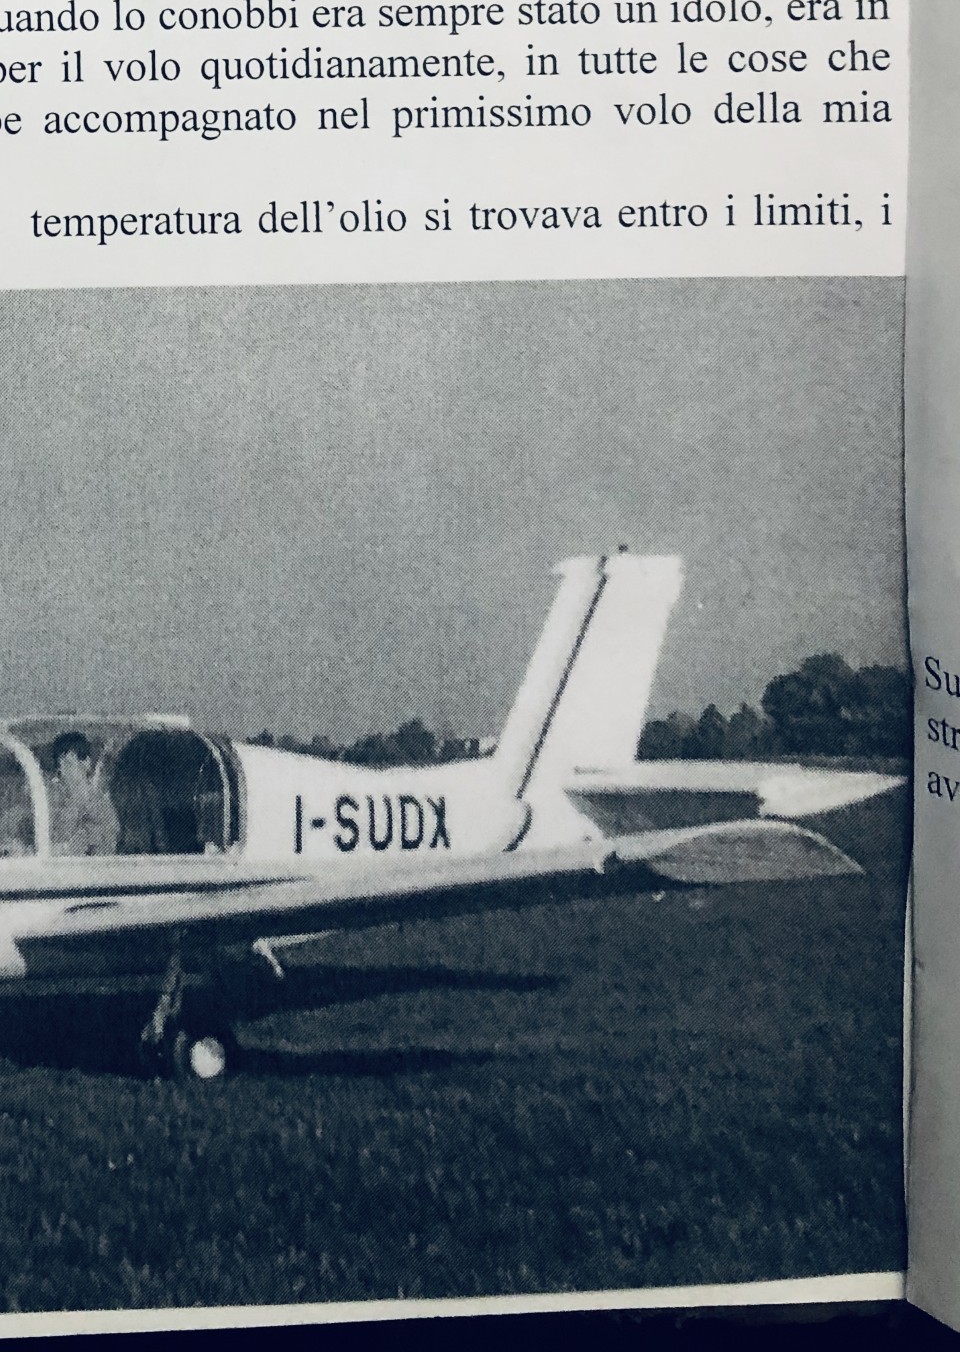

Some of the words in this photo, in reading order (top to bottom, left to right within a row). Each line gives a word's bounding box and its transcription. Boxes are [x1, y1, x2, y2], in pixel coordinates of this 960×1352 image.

[61, 49, 85, 83] il
[102, 48, 181, 82] volo
[200, 46, 506, 90] quotidianamente,
[525, 43, 560, 76] in
[577, 47, 658, 76] tutte
[677, 41, 708, 74] le
[727, 49, 808, 73] cose
[827, 39, 891, 72] che
[43, 102, 297, 142] accompagnato
[317, 96, 371, 130] nel
[391, 94, 592, 139] primissimo
[613, 92, 692, 126] volo
[713, 90, 803, 125] della
[822, 89, 893, 123] mia
[293, 794, 452, 854] I-SUDX
